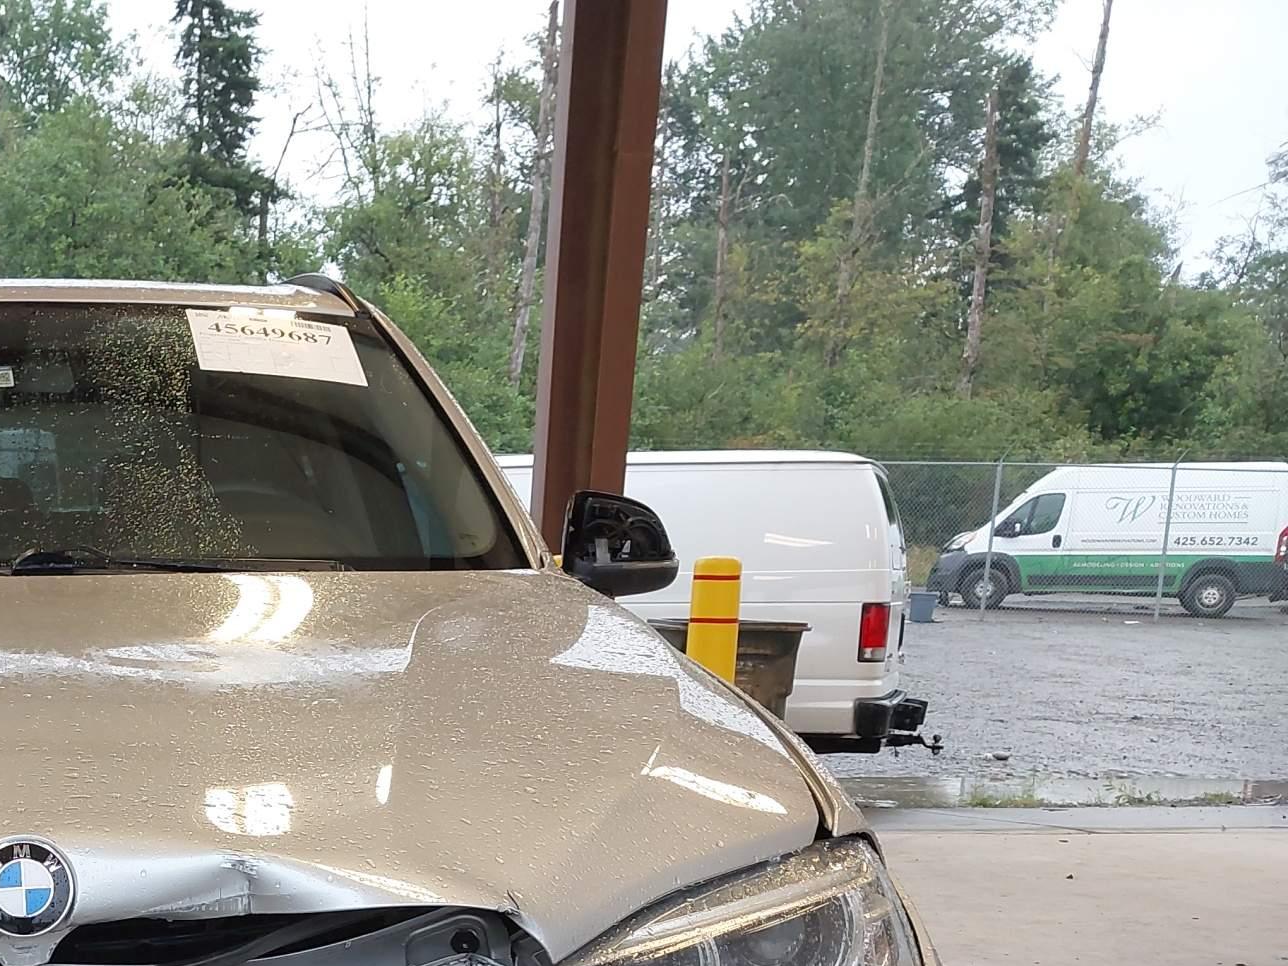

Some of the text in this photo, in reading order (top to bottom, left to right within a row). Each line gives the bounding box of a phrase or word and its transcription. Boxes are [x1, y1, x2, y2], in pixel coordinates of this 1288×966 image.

[207, 321, 333, 346] 45649687
[1105, 495, 1157, 524] W
[1209, 511, 1249, 520] HOMES
[1173, 536, 1259, 546] 425.652.7342
